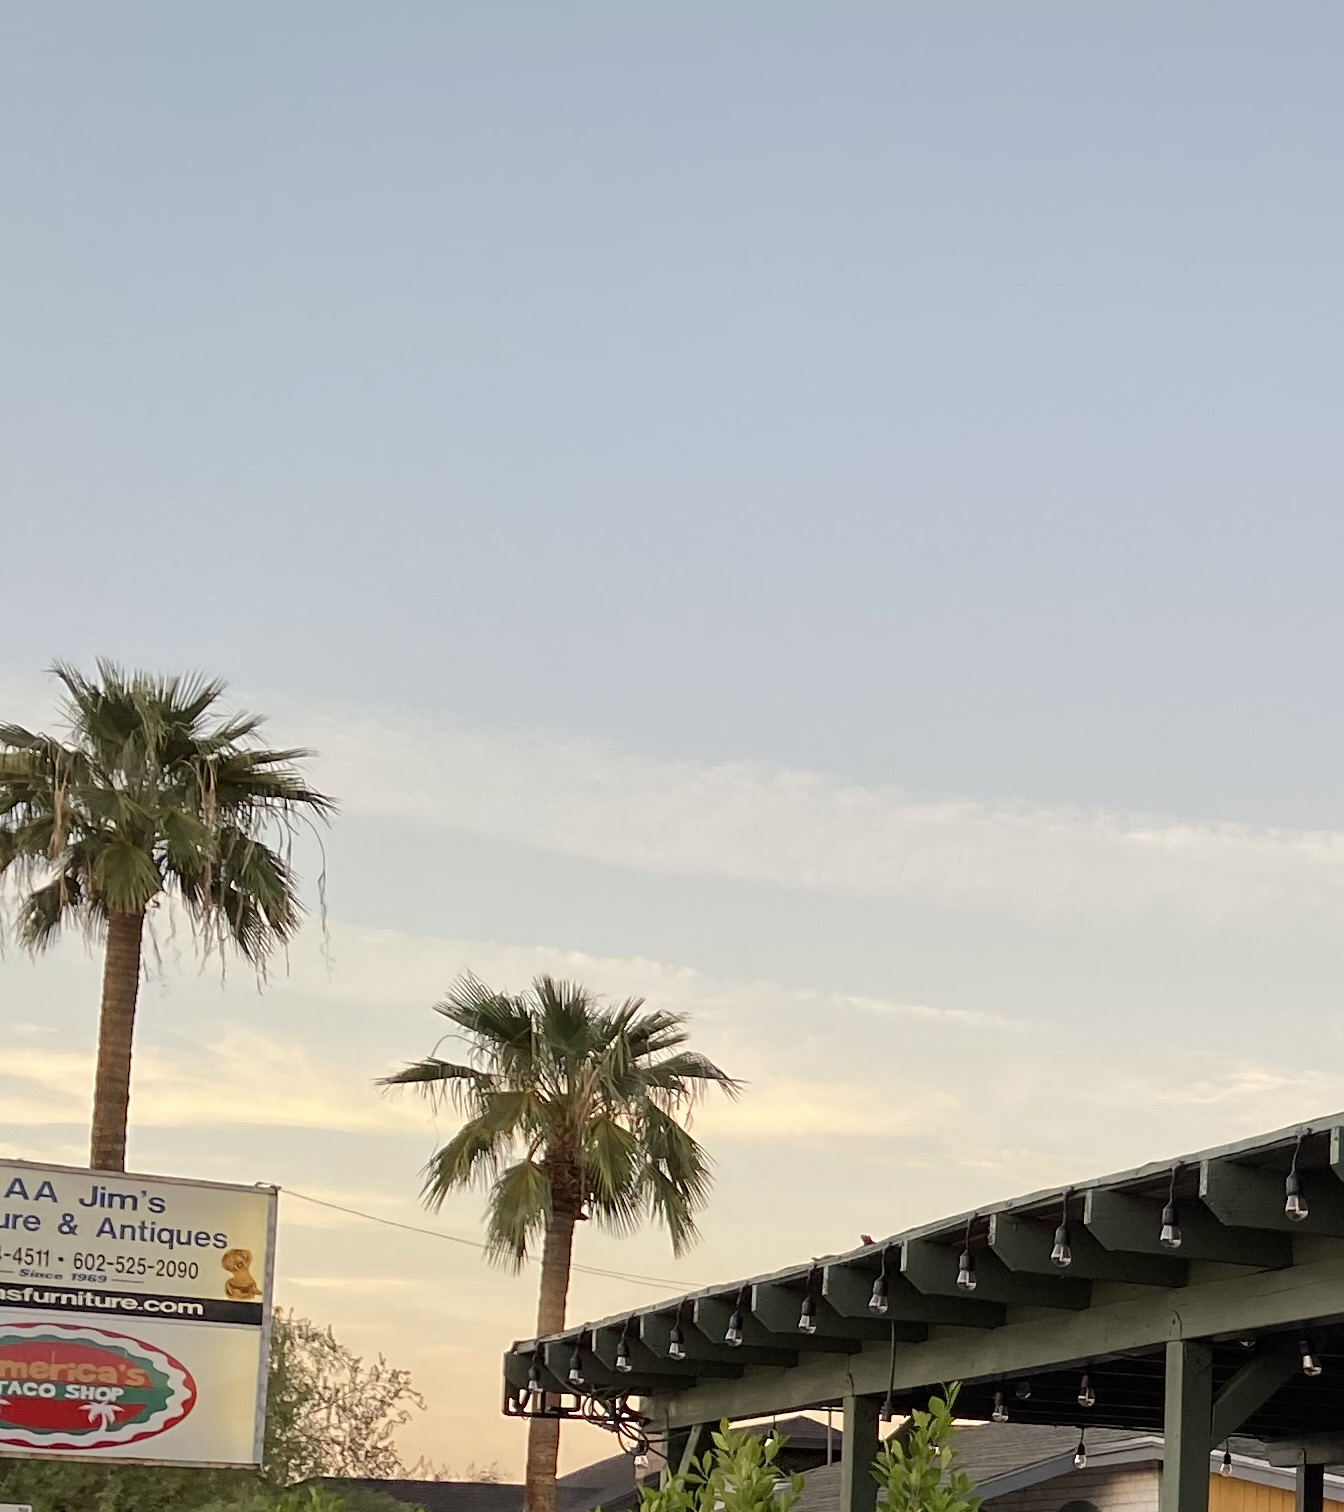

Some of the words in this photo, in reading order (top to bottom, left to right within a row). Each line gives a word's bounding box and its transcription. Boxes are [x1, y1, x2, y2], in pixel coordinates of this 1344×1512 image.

[78, 1184, 166, 1214] Jim's
[57, 1212, 78, 1236] &
[96, 1217, 228, 1250] Antiques
[0, 1246, 50, 1268] -4511
[73, 1252, 199, 1280] 602-525-2090
[19, 1268, 63, 1281] Since
[0, 1358, 147, 1388] merica's
[64, 1383, 125, 1402] SHOP
